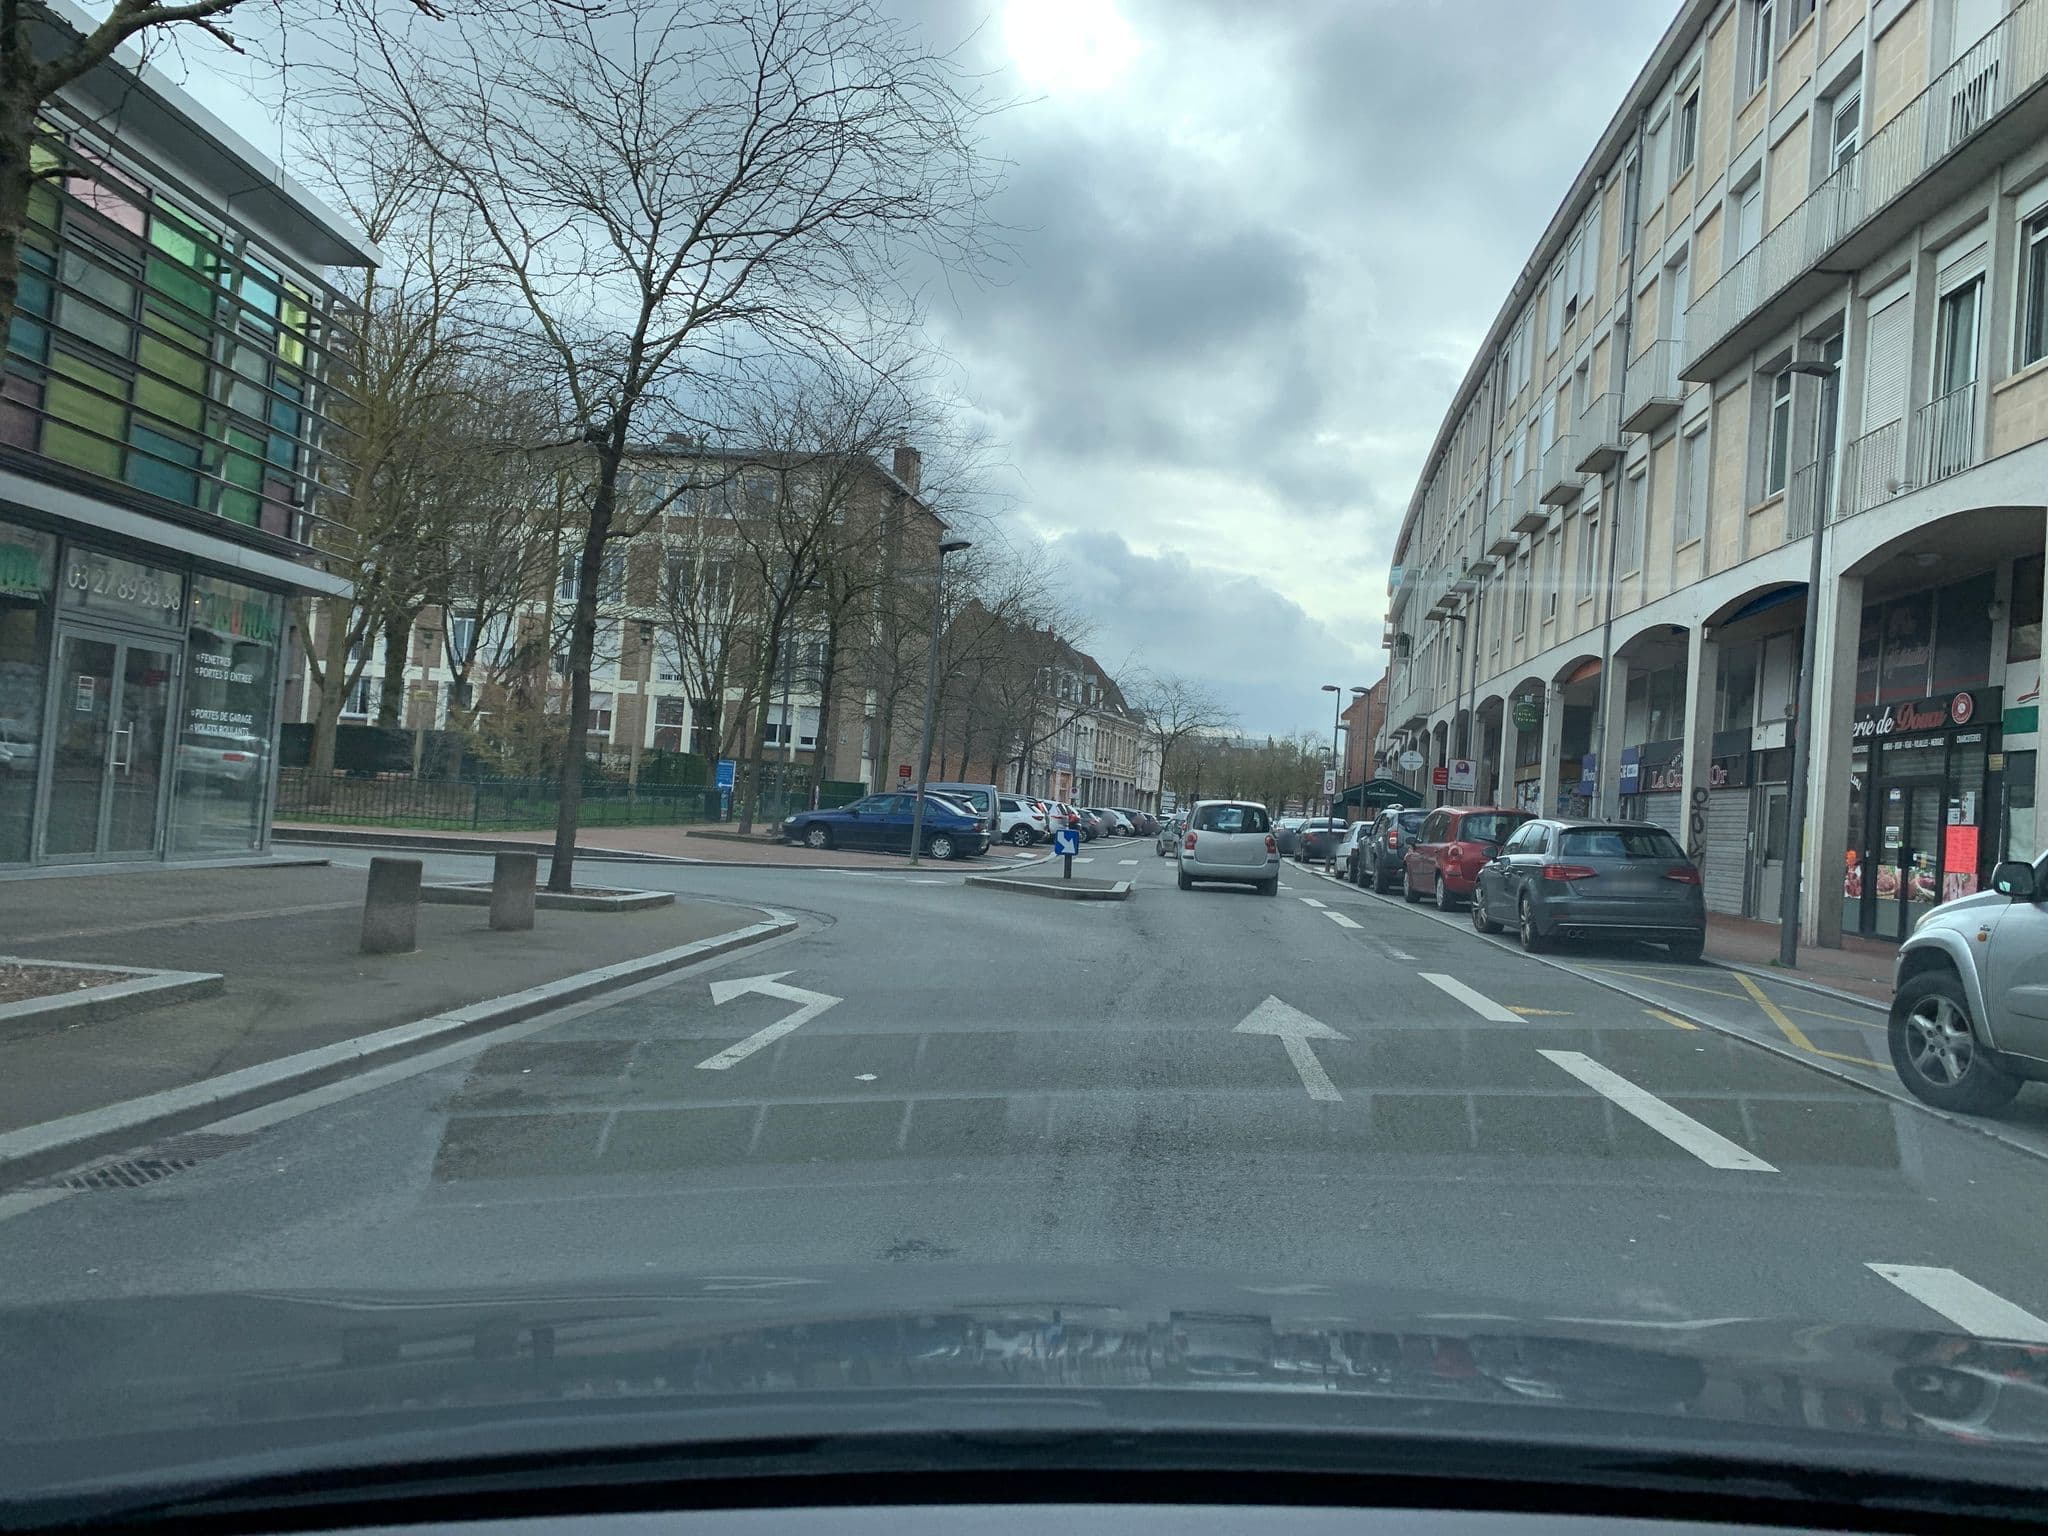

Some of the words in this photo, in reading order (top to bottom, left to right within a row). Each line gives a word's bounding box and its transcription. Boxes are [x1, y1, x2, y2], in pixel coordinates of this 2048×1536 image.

[68, 563, 89, 589] 03
[93, 569, 114, 594] 27
[117, 575, 137, 600] 89
[199, 667, 223, 680] PORTES
[194, 708, 218, 721] PORTES
[1876, 706, 1895, 735] de
